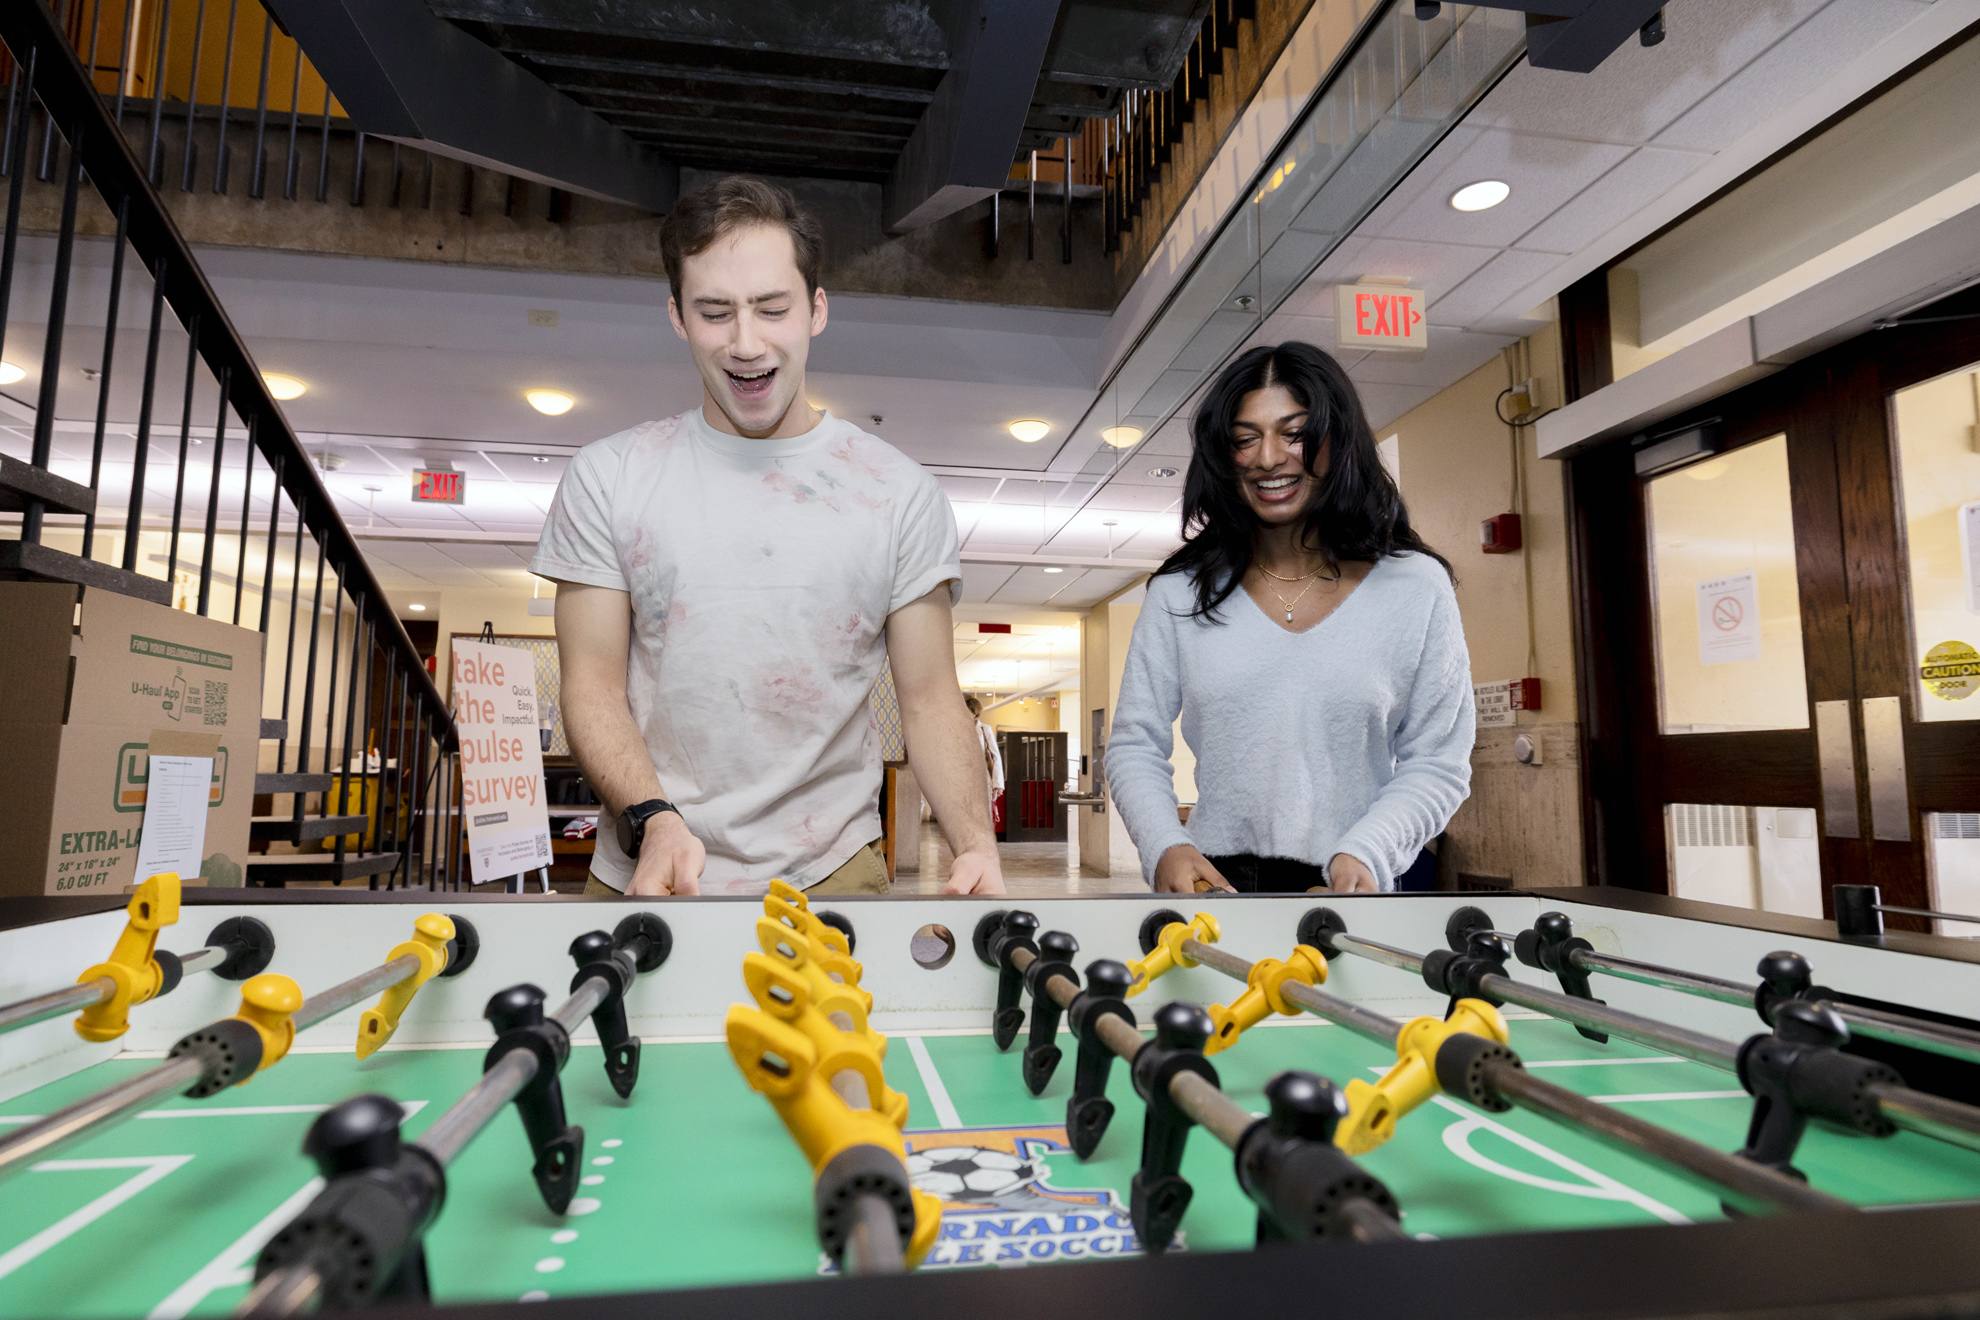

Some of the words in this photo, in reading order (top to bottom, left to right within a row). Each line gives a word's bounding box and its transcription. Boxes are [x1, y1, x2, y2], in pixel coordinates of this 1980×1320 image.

[1355, 293, 1413, 337] EXIT
[419, 472, 459, 500] EXIT
[132, 639, 149, 651] FIND
[149, 642, 166, 655] YOUR
[1926, 652, 1978, 662] AUTOMATIC
[453, 651, 505, 687] take
[1922, 663, 1980, 678] CAUTION
[164, 687, 180, 701] App
[512, 685, 533, 697] Quick.
[1940, 680, 1968, 689] DOOR
[455, 690, 495, 724] the
[517, 700, 534, 713] Easy.
[502, 713, 536, 726] Impactful.
[459, 730, 523, 774] pulse
[463, 774, 537, 807] survey
[60, 828, 142, 855] EXTRA-LA
[58, 861, 74, 873] 24"
[75, 862, 82, 871] x
[84, 858, 99, 870] 18"
[99, 860, 105, 868] x
[106, 856, 120, 868] 24"
[56, 876, 75, 891] 6.0
[77, 873, 93, 888] CU
[94, 872, 109, 886] FT
[939, 1213, 1134, 1240] RNADO
[997, 1234, 1183, 1260] SOCCE
